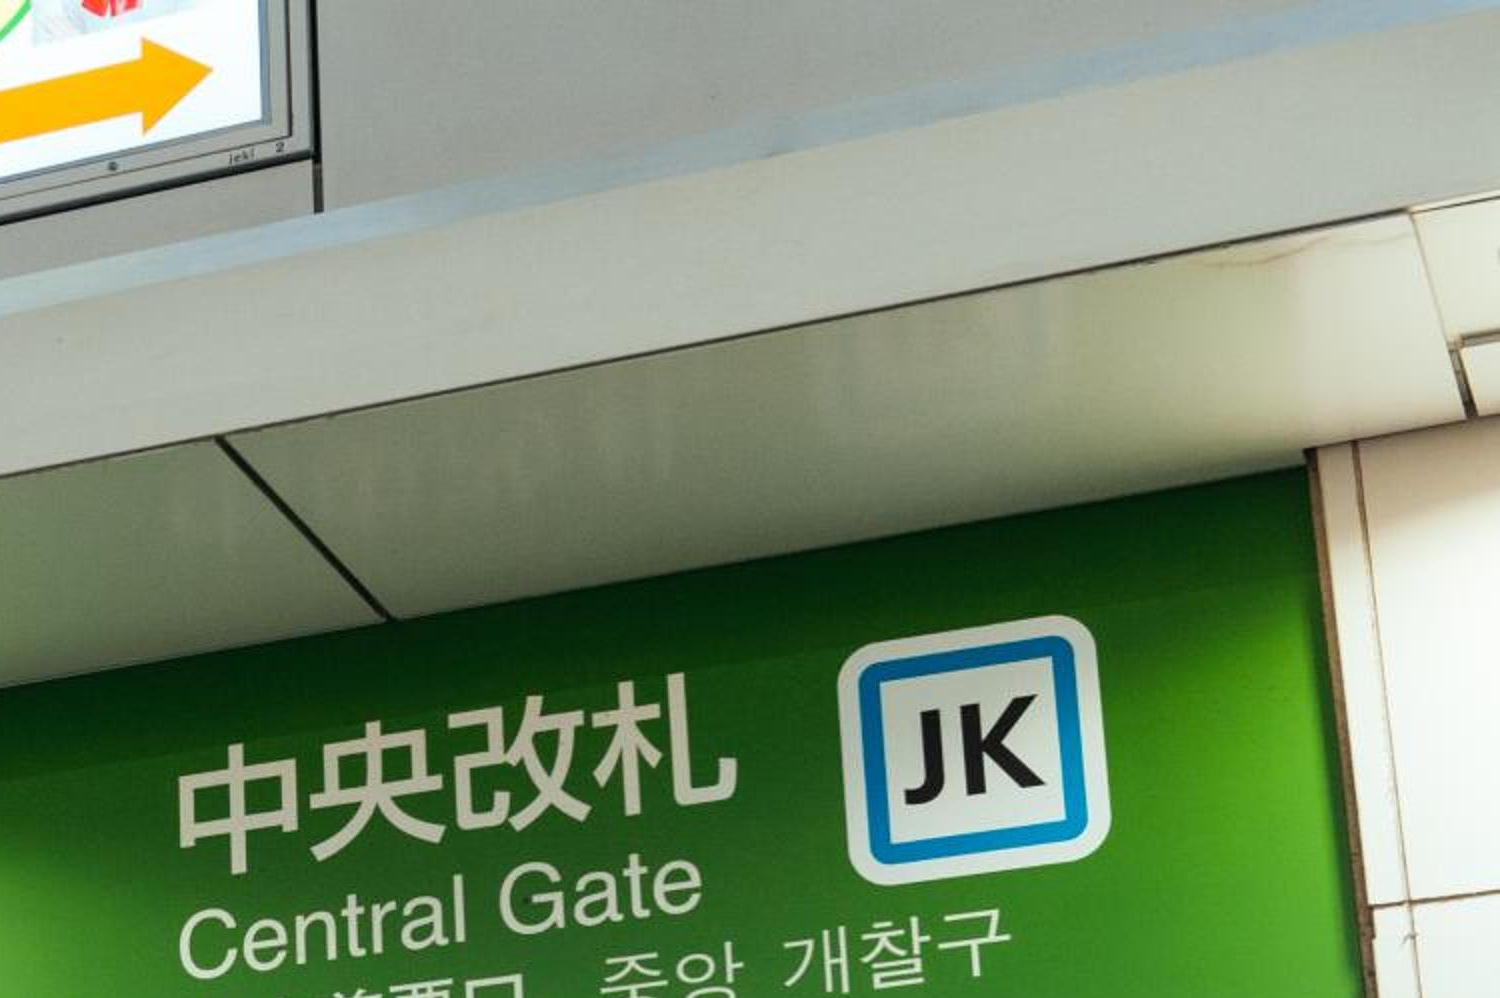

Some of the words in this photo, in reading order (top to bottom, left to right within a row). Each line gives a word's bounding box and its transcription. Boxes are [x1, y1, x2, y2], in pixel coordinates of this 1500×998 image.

[178, 672, 737, 875] 中央改札
[904, 694, 1045, 805] JK
[178, 875, 466, 979] Central
[499, 853, 702, 935] Gate
[784, 908, 1013, 994] 개찰구
